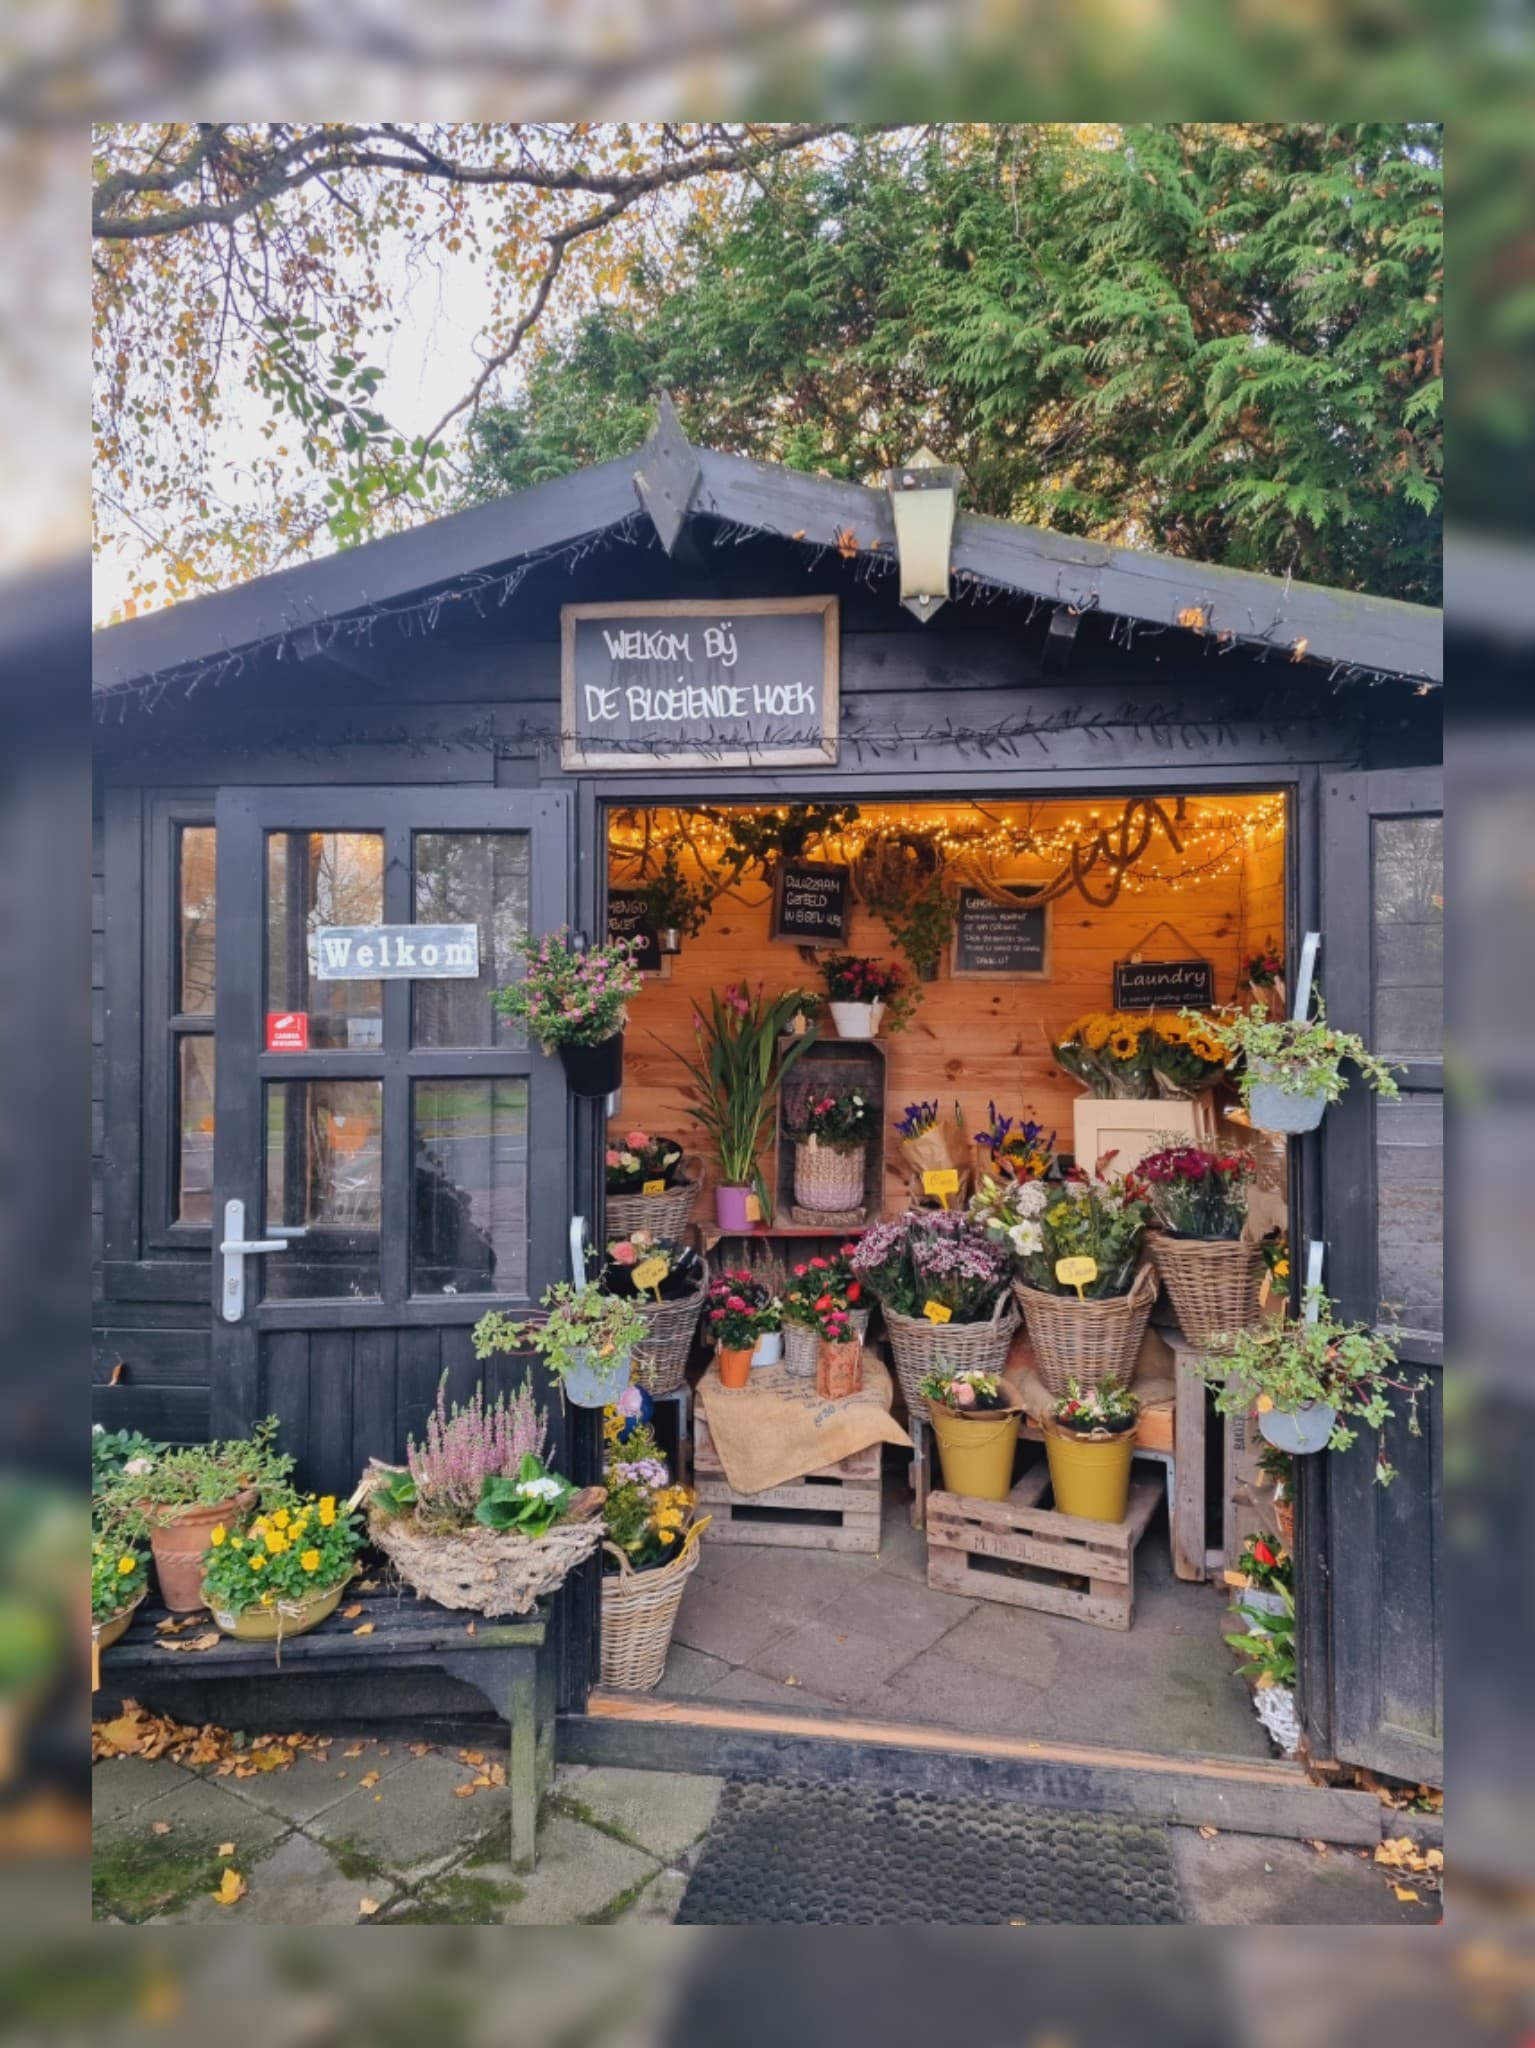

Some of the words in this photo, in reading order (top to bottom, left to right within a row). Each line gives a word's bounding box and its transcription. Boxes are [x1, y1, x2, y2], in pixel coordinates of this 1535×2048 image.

[603, 630, 693, 662] WELKOM
[584, 683, 621, 722] DE
[753, 681, 816, 717] HOEK
[323, 936, 474, 969] Welkom
[1120, 967, 1207, 988] Laundry
